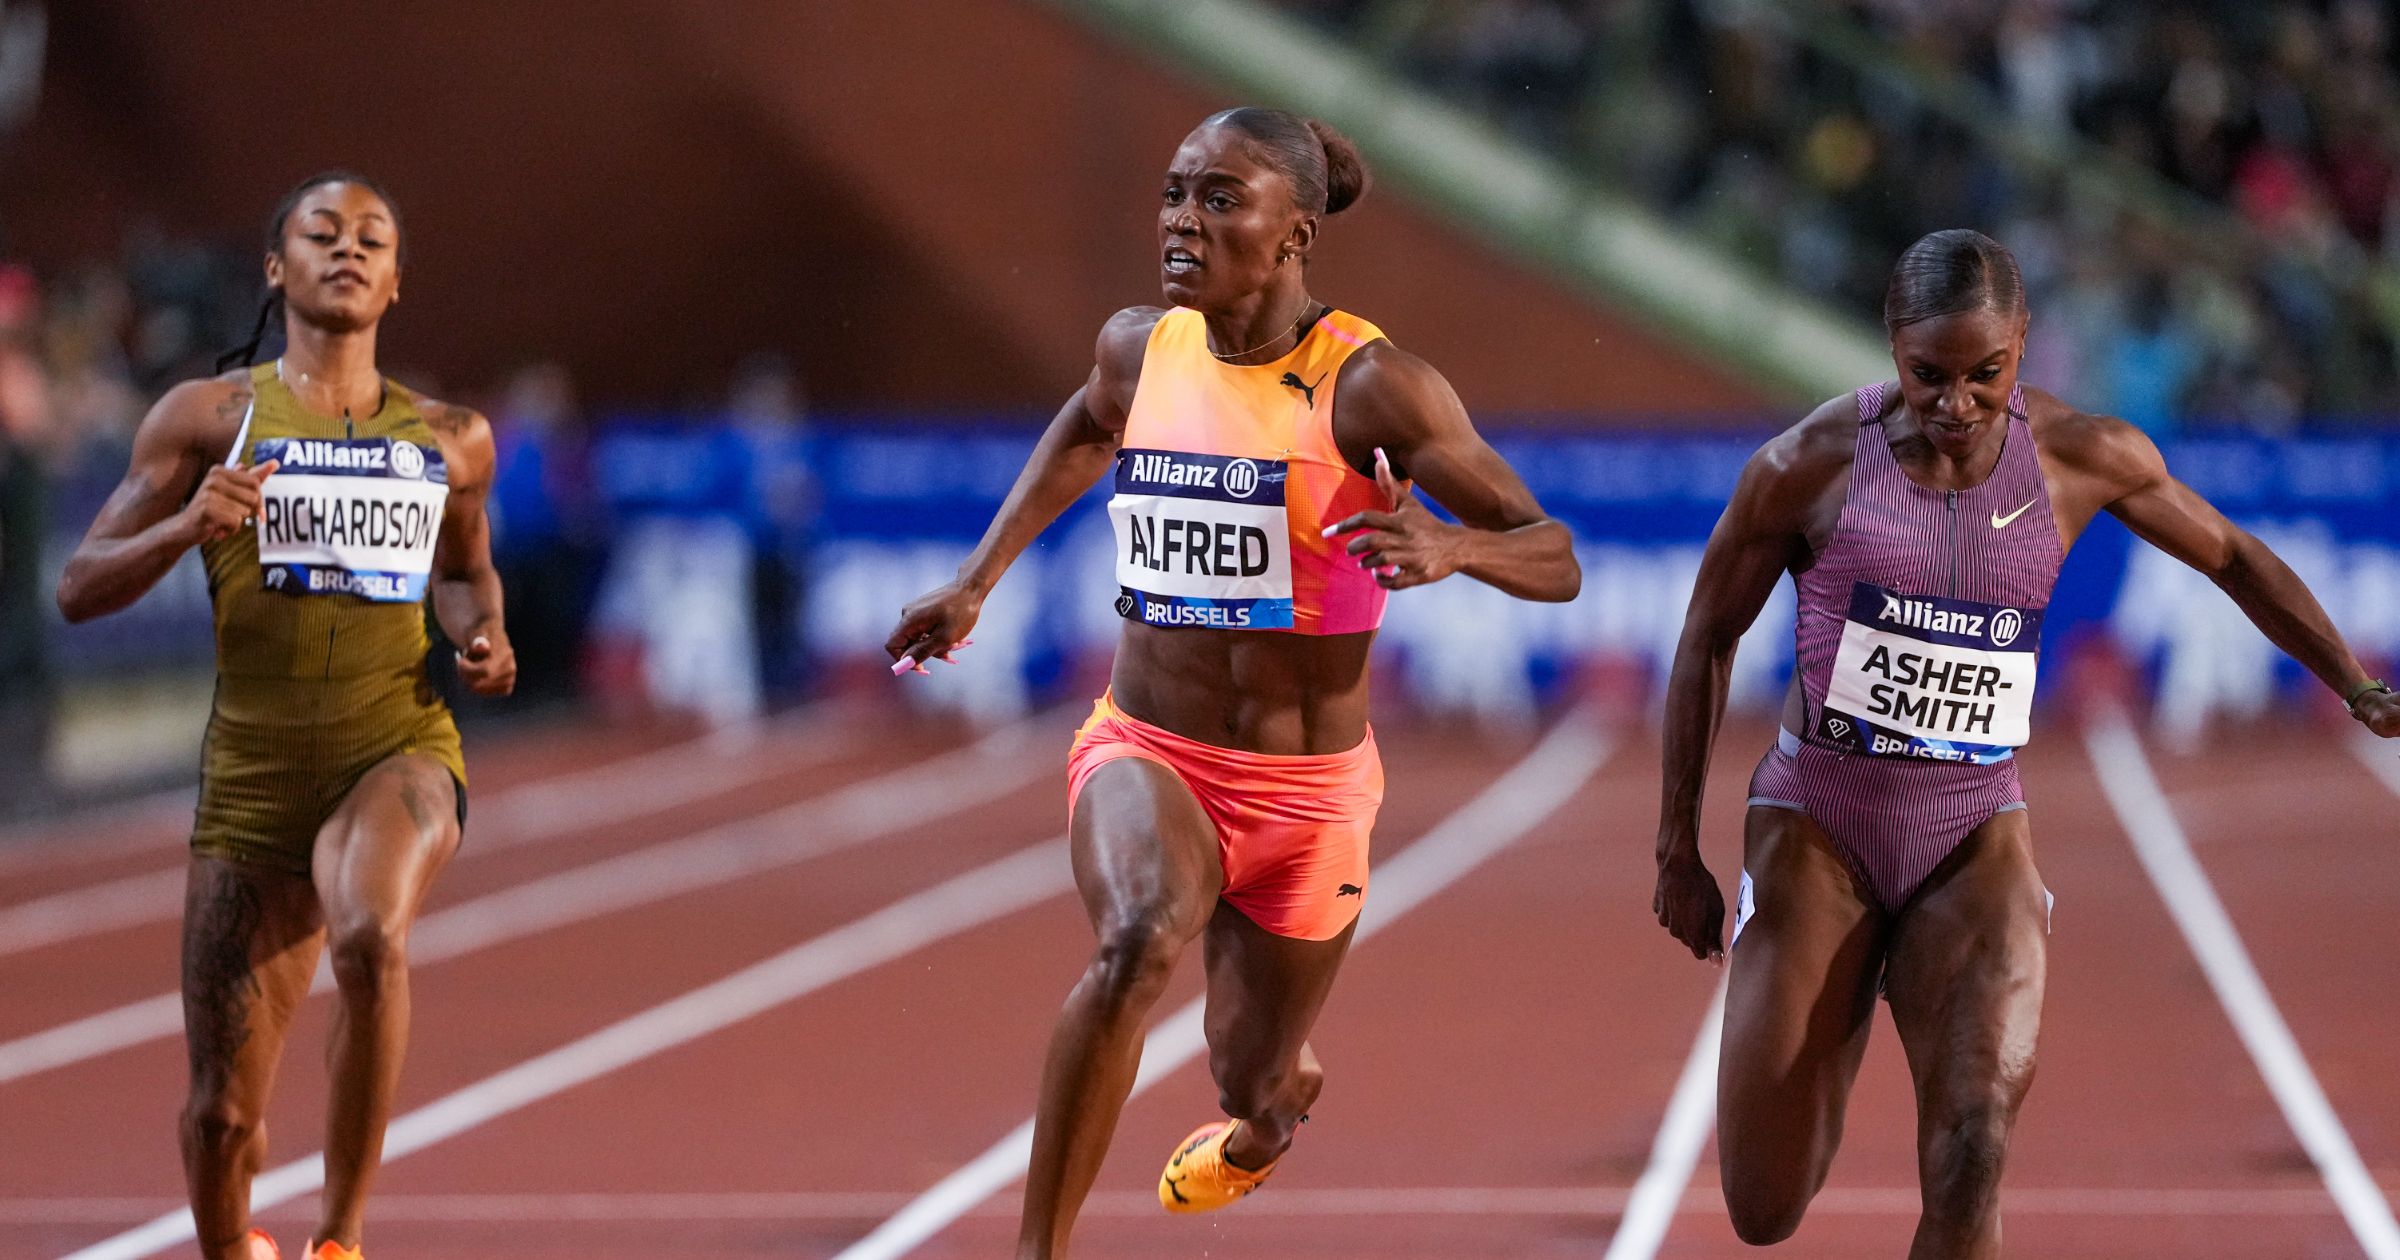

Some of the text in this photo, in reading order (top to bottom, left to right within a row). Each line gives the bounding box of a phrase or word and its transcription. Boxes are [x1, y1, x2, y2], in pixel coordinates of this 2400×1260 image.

[283, 440, 387, 469] Allianz
[1130, 454, 1218, 488] Allianz
[264, 496, 437, 550] RICHARDSON
[1130, 514, 1269, 577] ALFRED
[309, 569, 408, 598] BRUSSELS
[1145, 601, 1251, 626] BRUSSELS
[1878, 597, 1984, 637] Allianz
[1861, 644, 2012, 697] ASHER-
[1866, 684, 1995, 734] SMITH
